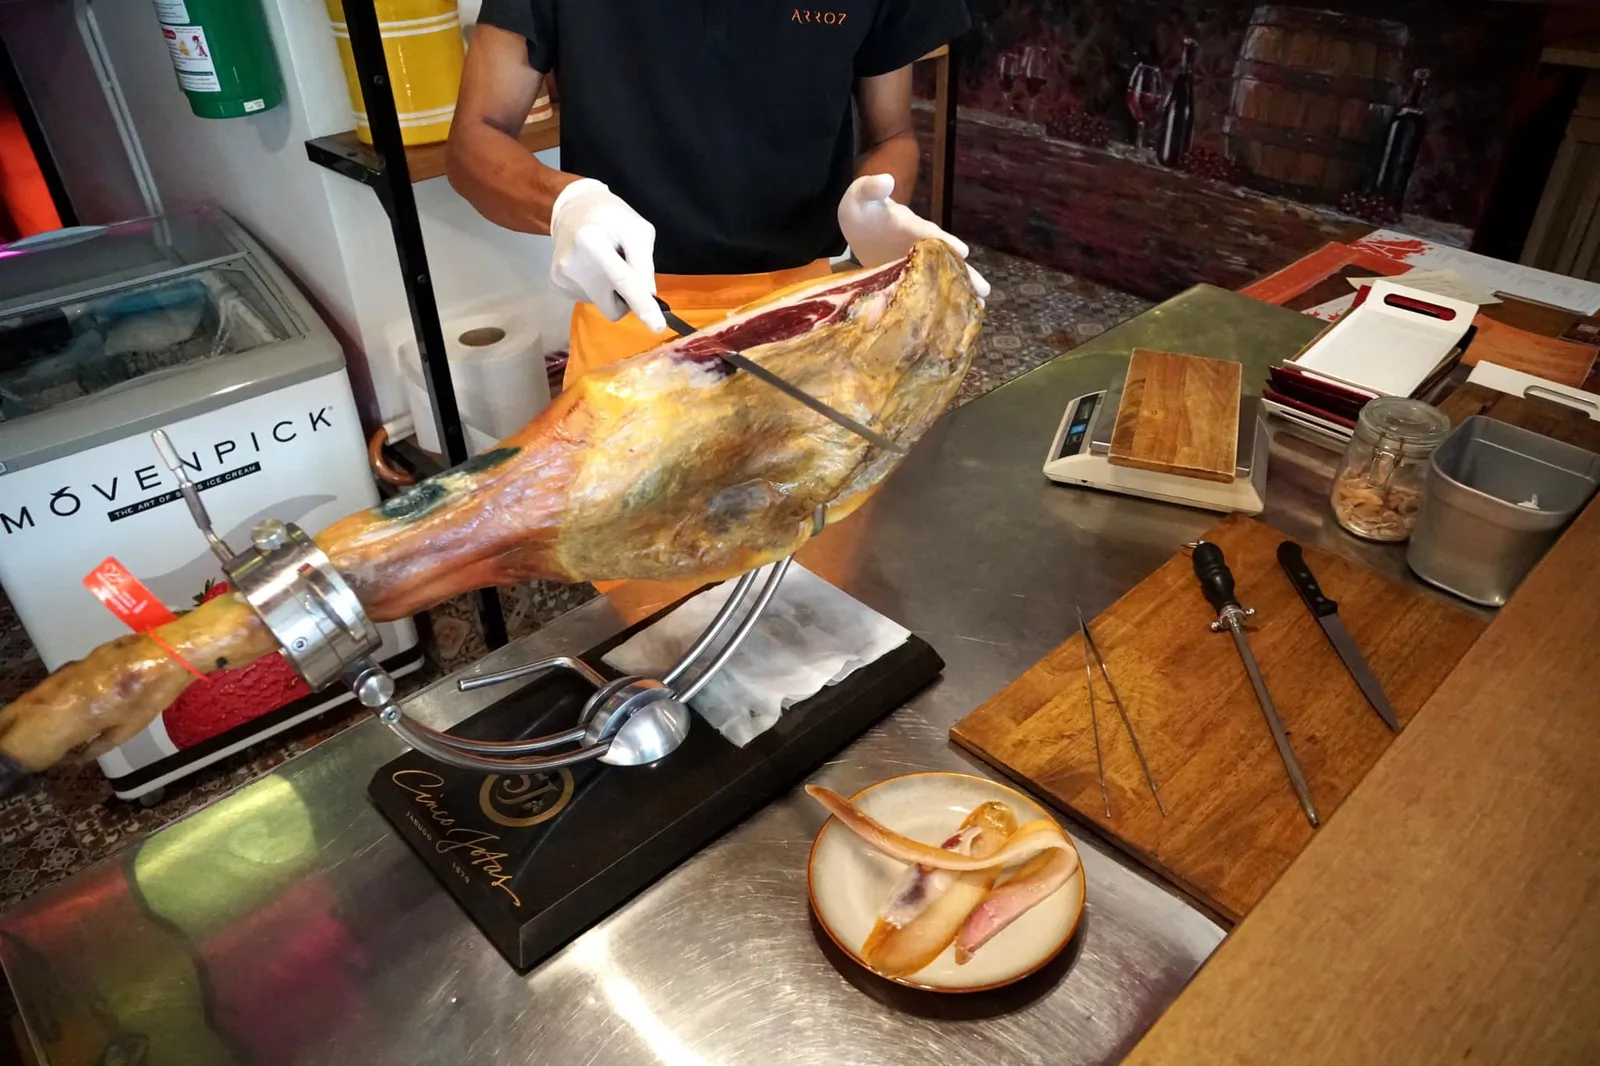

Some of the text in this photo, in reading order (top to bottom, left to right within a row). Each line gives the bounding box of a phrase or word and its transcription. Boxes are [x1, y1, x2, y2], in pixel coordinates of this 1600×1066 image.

[114, 466, 256, 518] THE ART OF ICE CREAM
[392, 770, 521, 907] Cinco Jotas
